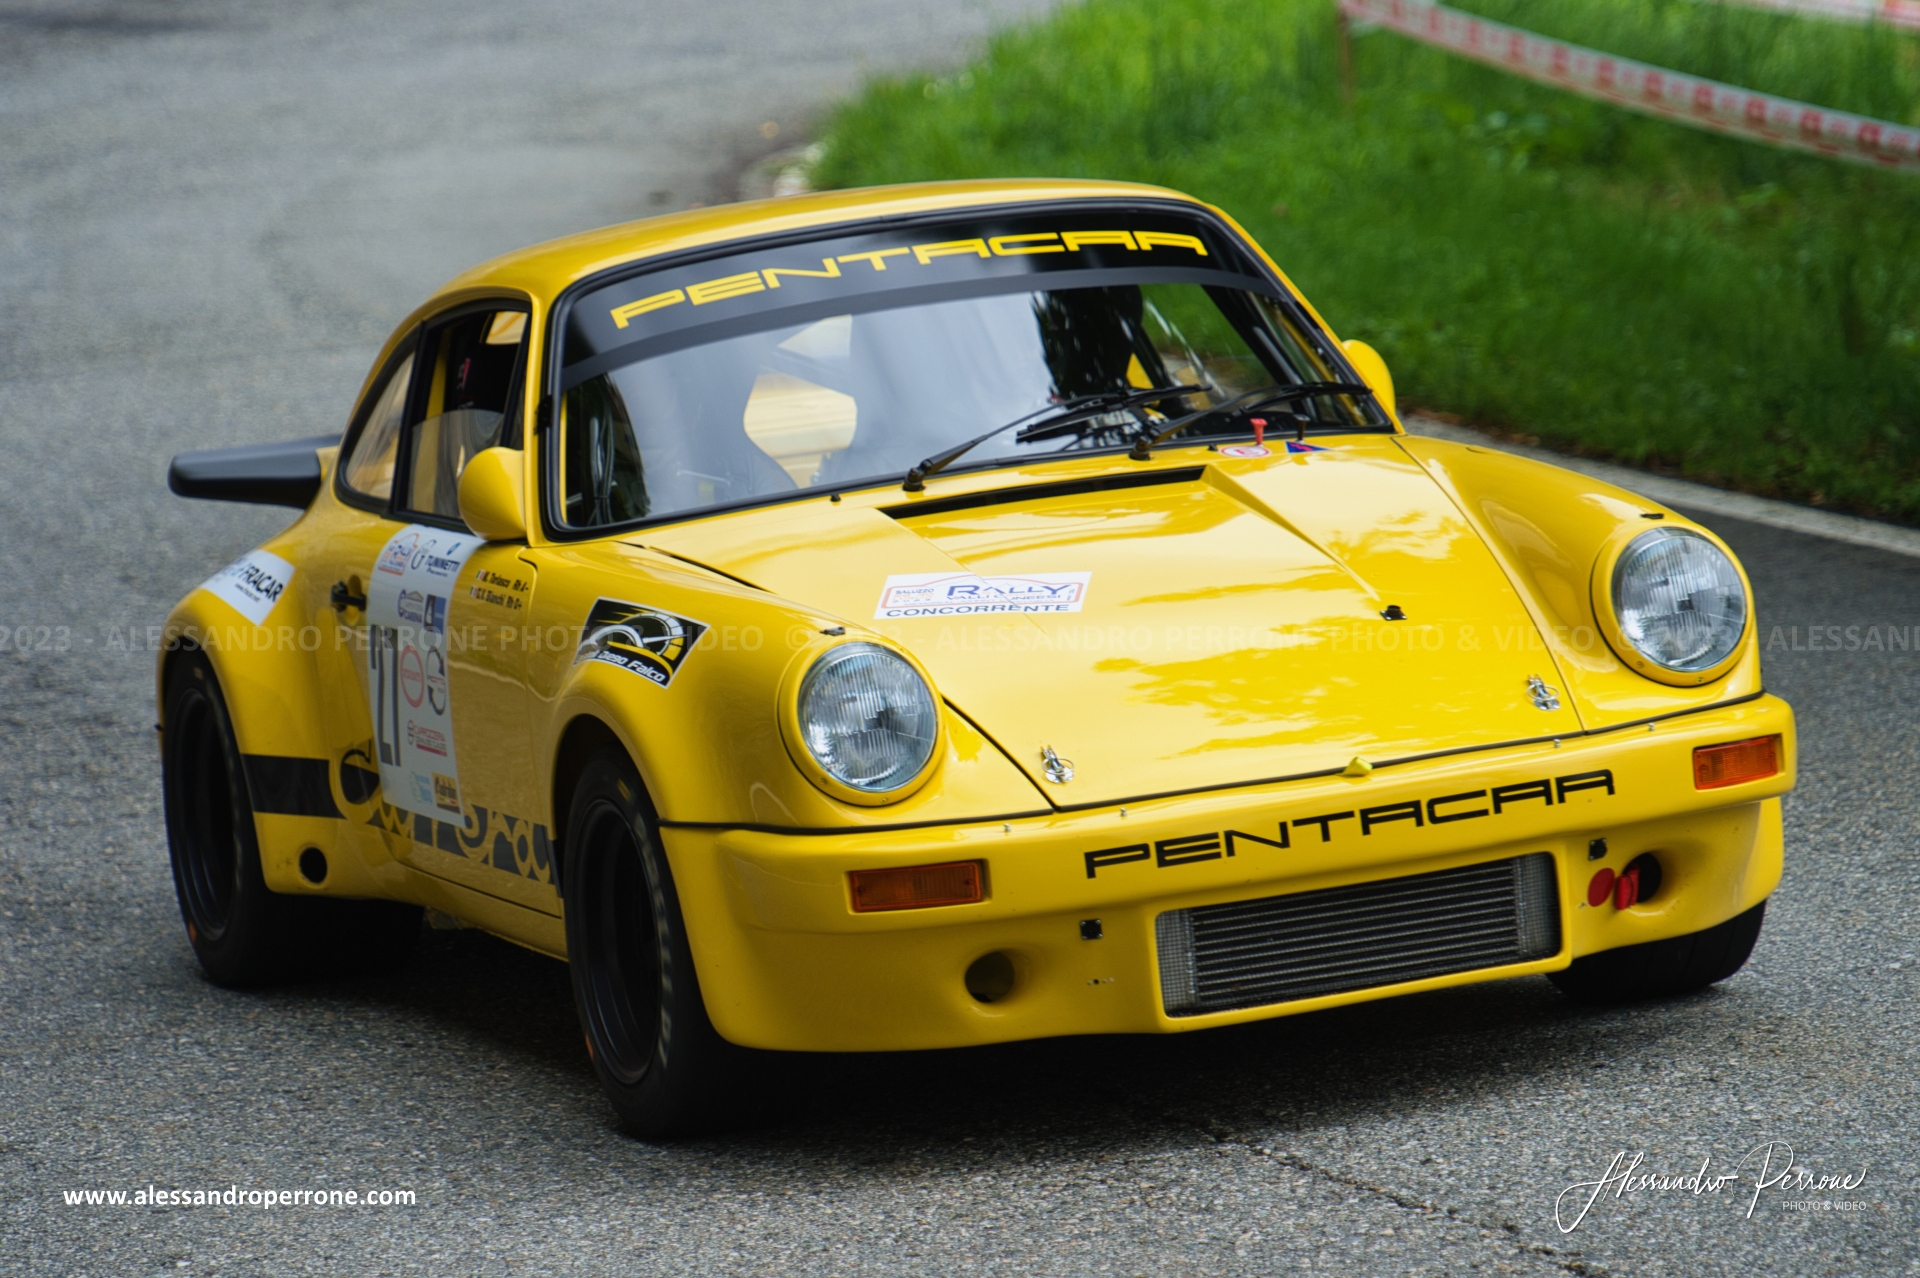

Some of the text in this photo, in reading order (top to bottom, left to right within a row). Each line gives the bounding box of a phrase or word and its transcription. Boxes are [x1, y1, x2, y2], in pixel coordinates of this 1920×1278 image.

[610, 231, 1209, 330] PENTACAR
[238, 565, 284, 603] FRACAR
[947, 584, 1072, 596] RALLY
[886, 604, 1070, 617] CONCORRENTE
[627, 660, 666, 681] Falco
[1084, 769, 1615, 879] PENTACAR
